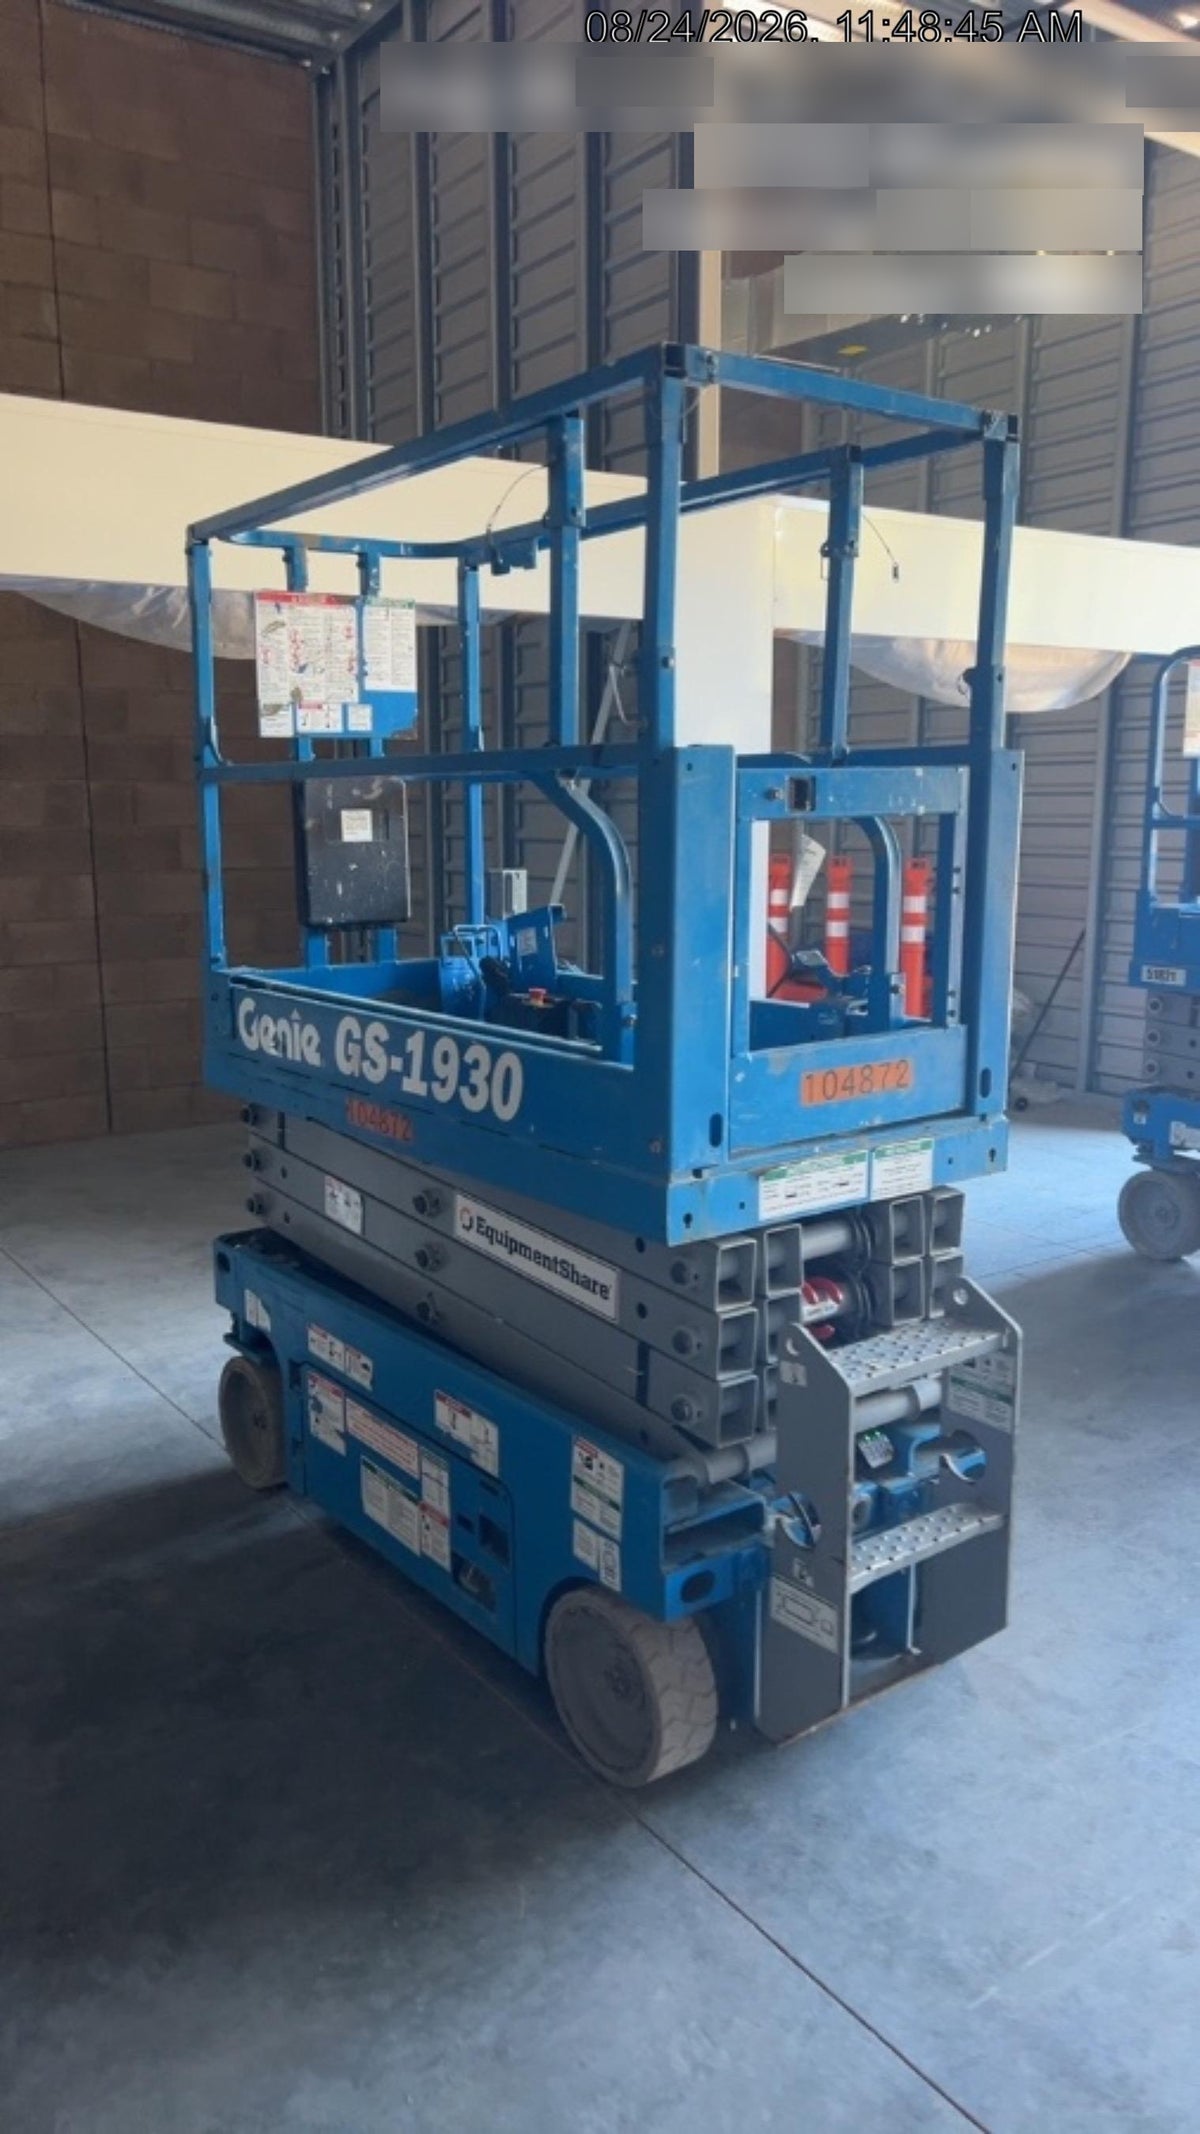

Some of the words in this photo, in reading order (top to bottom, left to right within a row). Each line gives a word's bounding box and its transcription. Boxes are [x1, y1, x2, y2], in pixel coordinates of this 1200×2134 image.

[238, 998, 322, 1068] Genie
[335, 1016, 523, 1121] GS-1930
[805, 1060, 909, 1104] 104872
[475, 1215, 611, 1300] EquipmentShare
